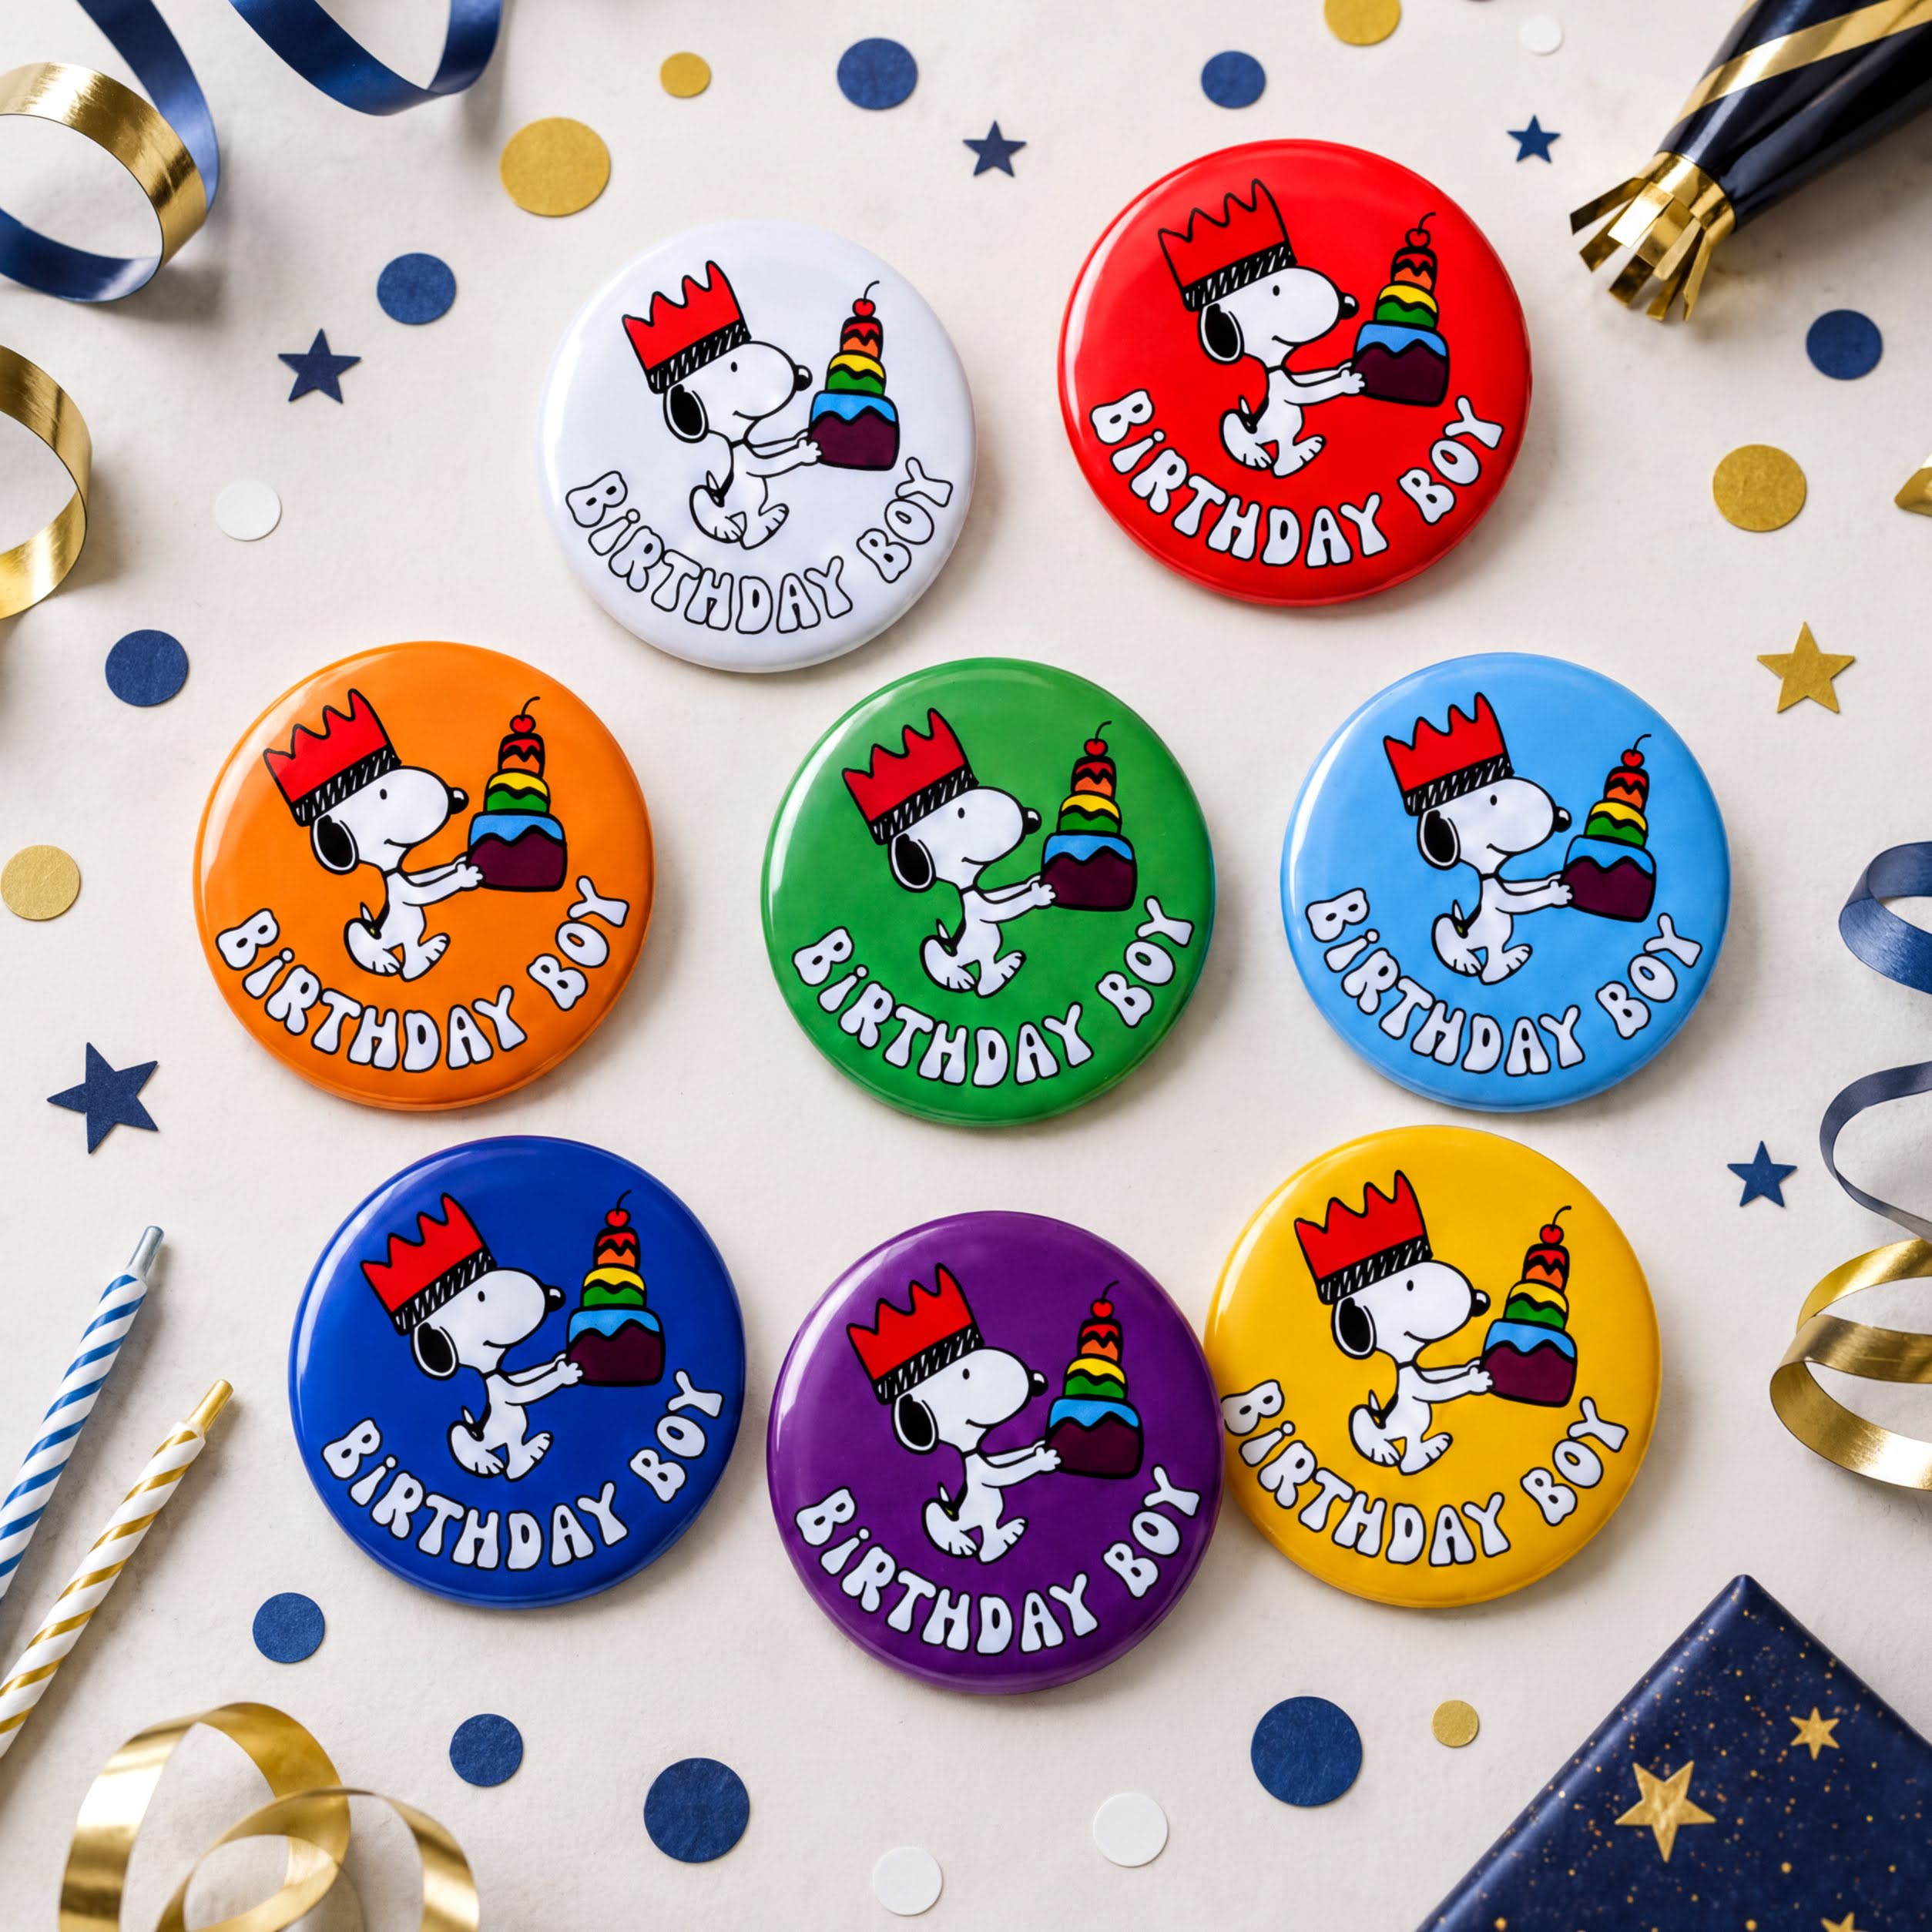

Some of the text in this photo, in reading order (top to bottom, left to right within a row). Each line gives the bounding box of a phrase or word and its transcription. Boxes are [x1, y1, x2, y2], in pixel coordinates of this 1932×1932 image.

[857, 457, 953, 583] BOY
[1397, 395, 1504, 525] BOY
[526, 876, 629, 1011] BOY
[1095, 895, 1195, 1028] BOY
[1595, 913, 1702, 1040] BOY
[628, 1370, 724, 1503] BOY
[1521, 1397, 1628, 1526] BOY
[1101, 1464, 1202, 1599] BOY
